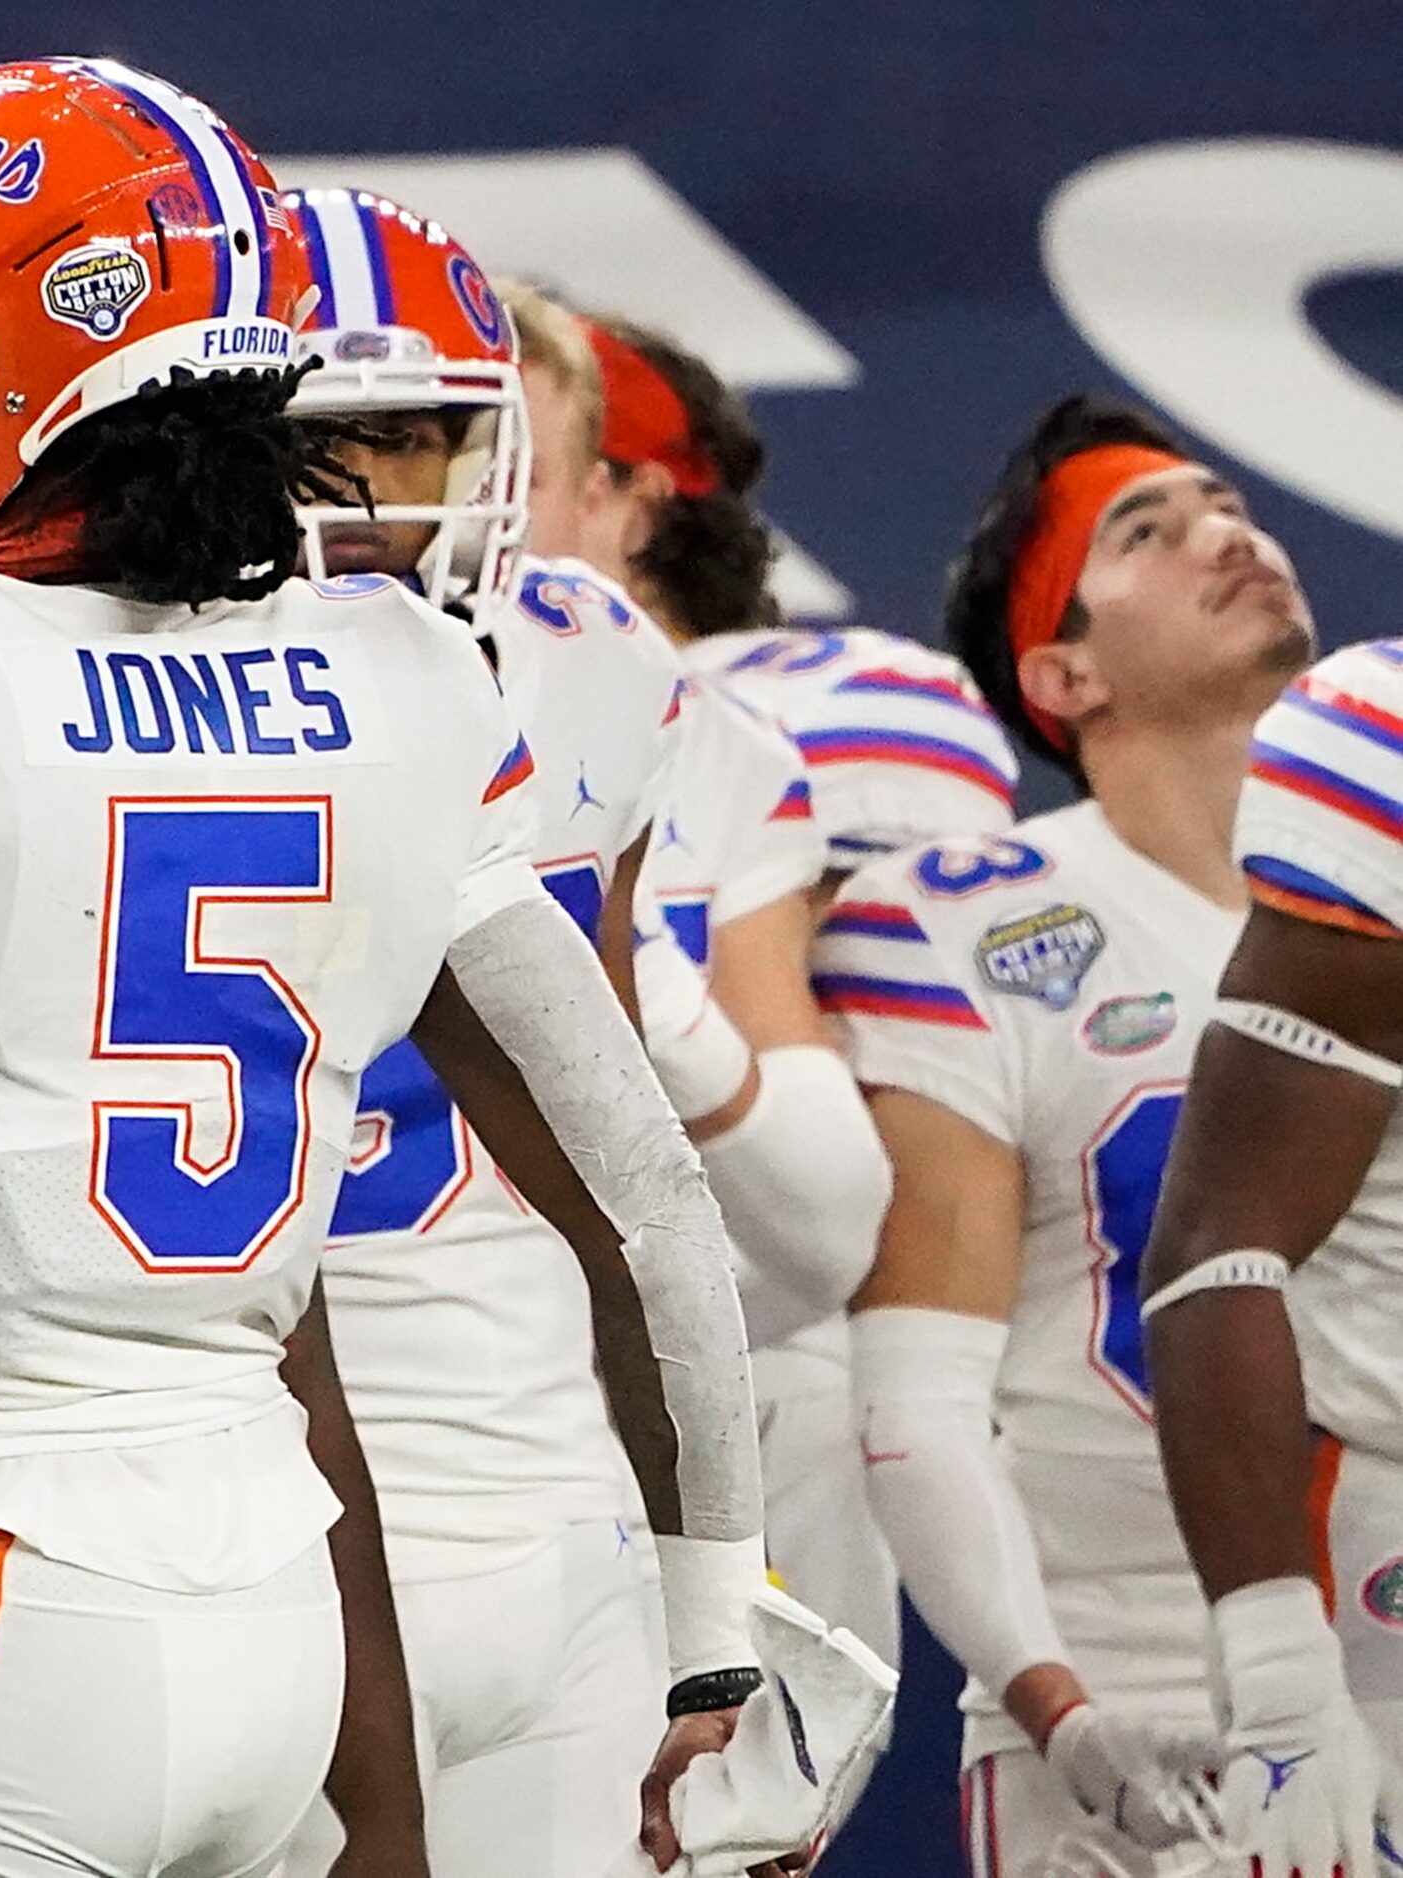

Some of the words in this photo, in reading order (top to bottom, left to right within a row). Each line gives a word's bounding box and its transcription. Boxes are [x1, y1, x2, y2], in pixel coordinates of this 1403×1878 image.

[52, 254, 130, 282] GOODYEAR
[54, 264, 138, 308] COTTON
[73, 284, 125, 312] BOWL
[204, 326, 289, 358] FLORIDA
[63, 648, 352, 754] JONES
[90, 795, 332, 1274] 5
